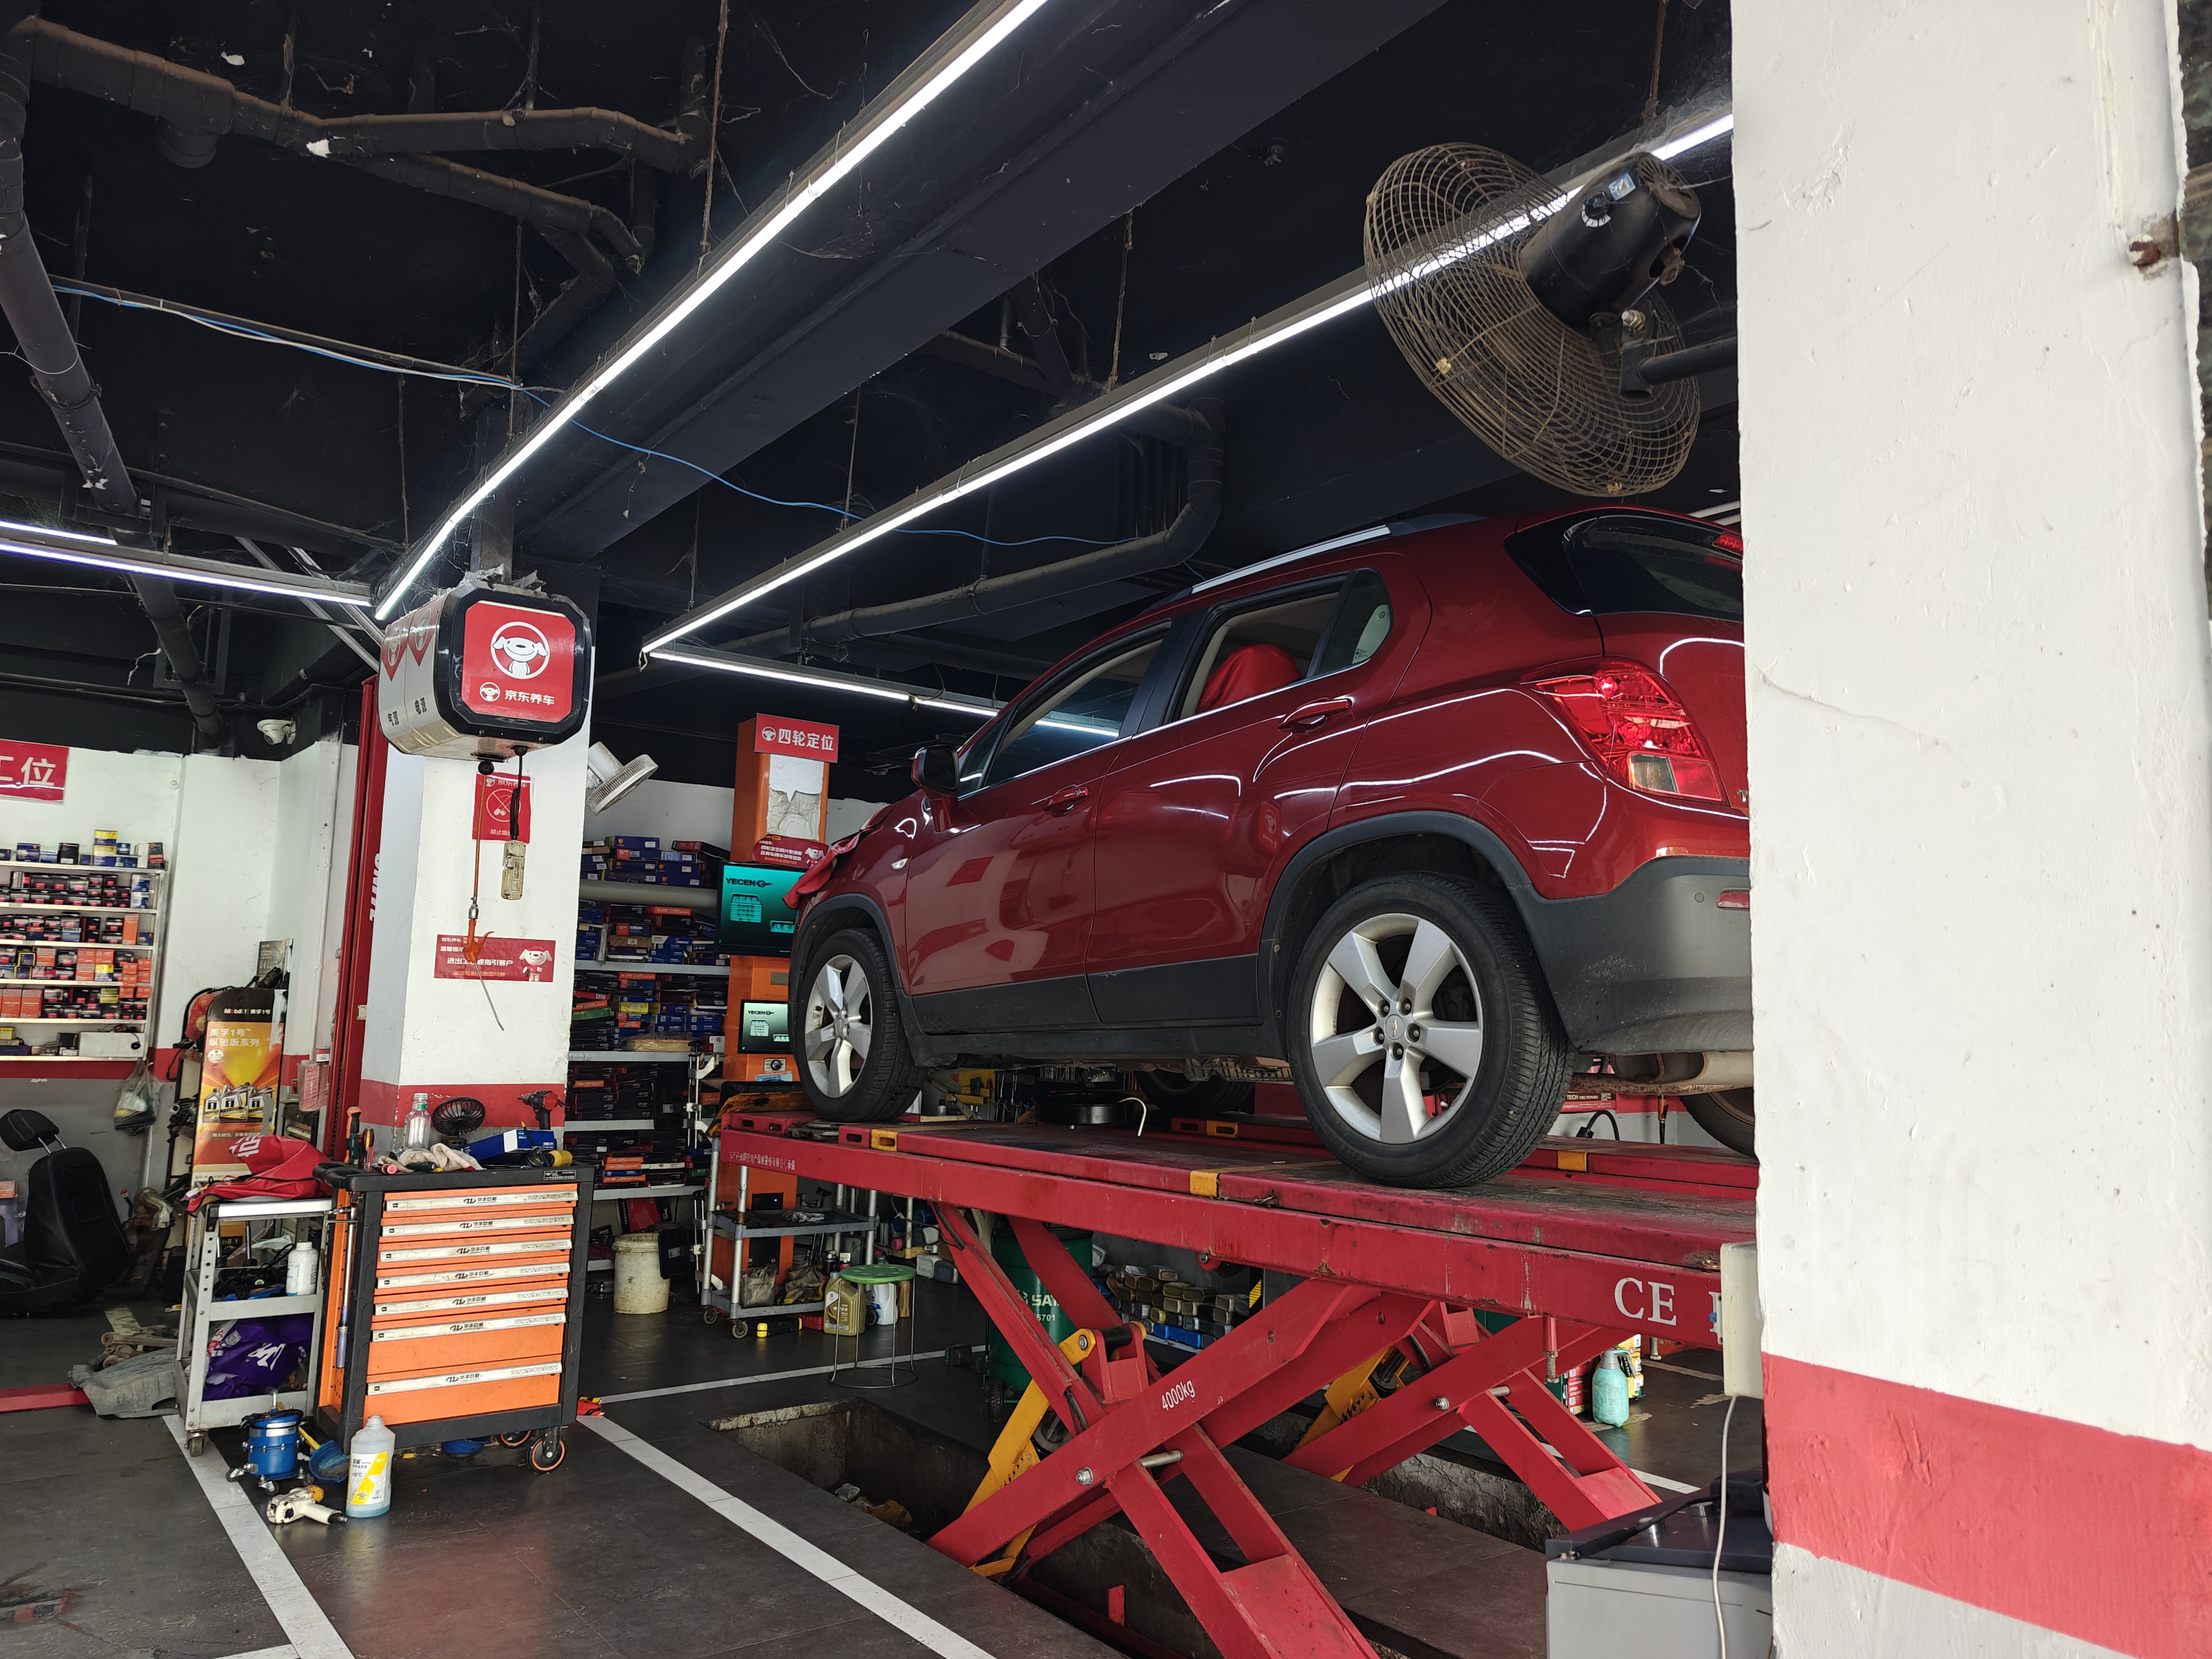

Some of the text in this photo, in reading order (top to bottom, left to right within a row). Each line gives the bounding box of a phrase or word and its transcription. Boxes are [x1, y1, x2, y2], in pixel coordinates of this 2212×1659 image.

[504, 690, 555, 706] 京东养车
[778, 728, 834, 751] 四轮定位
[497, 779, 528, 788] 京东养车
[726, 877, 756, 886] YECEN
[447, 957, 514, 967] 进出工要指引客户
[208, 1038, 259, 1047] 纵驰版系列
[1614, 1277, 1676, 1326] CE
[1162, 1380, 1195, 1411] 4000kg
